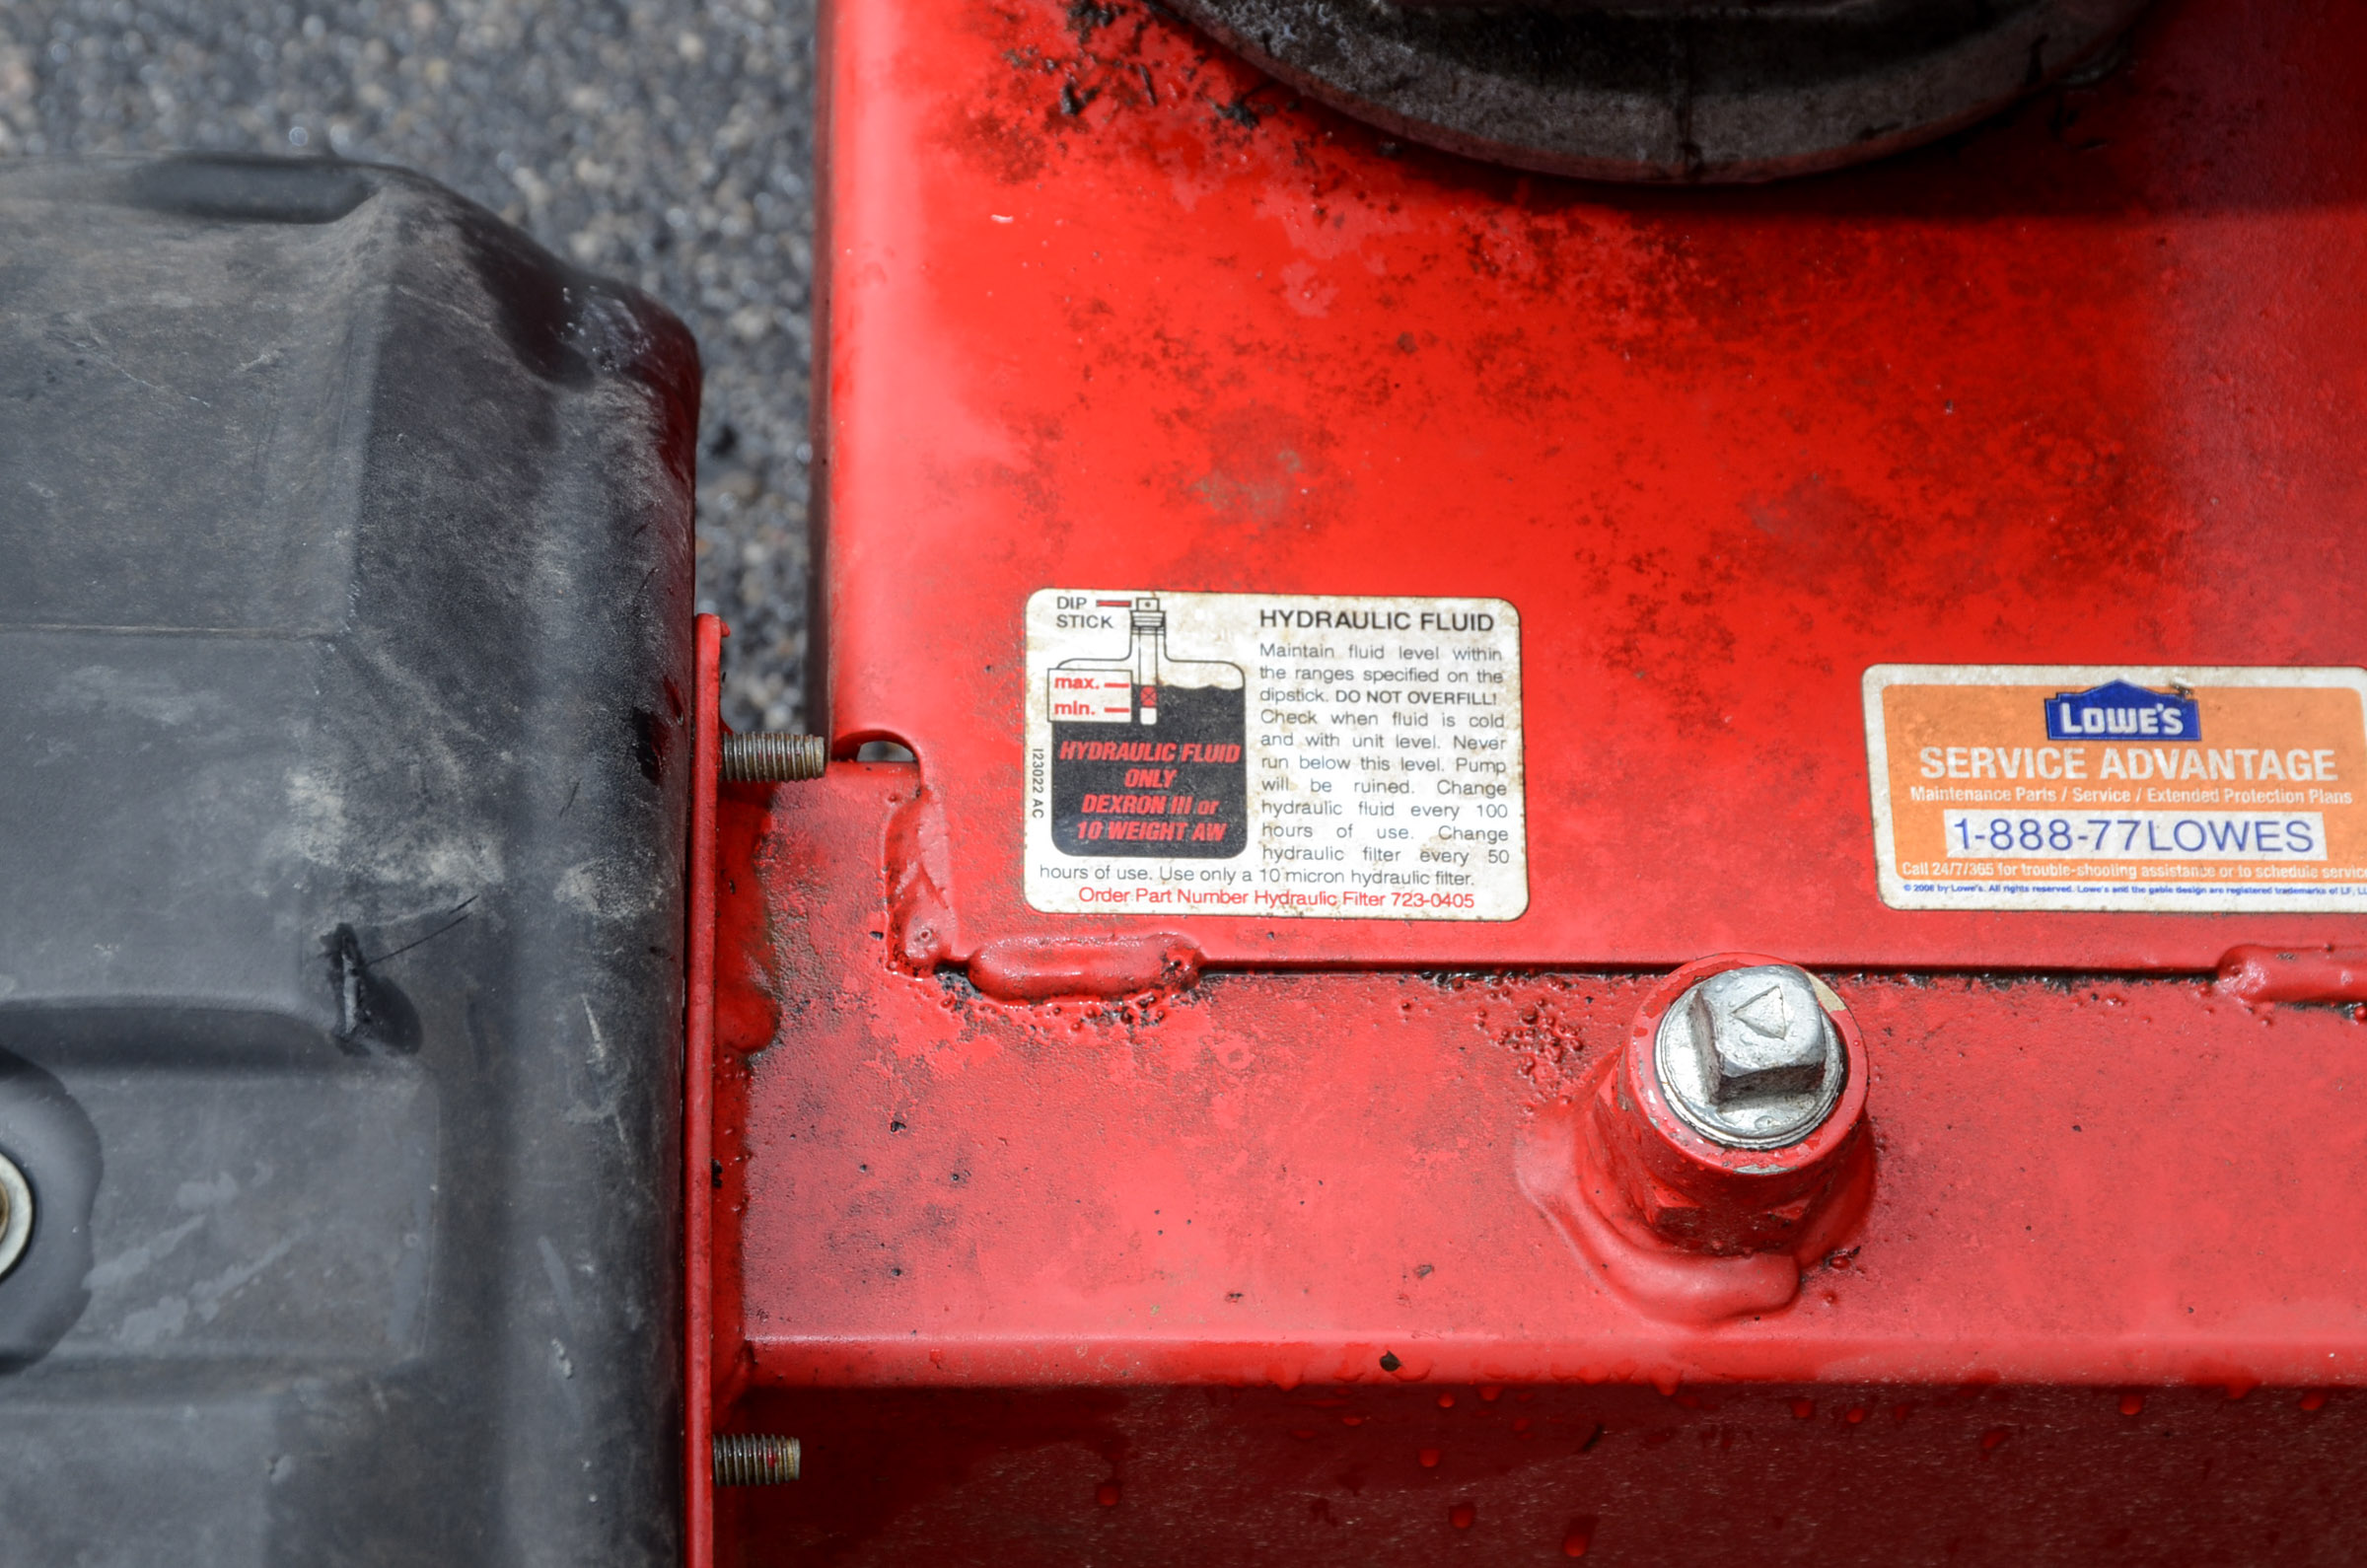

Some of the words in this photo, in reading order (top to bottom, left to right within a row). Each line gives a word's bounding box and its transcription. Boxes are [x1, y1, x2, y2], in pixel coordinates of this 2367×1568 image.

[1056, 596, 1087, 610] DIP
[1056, 614, 1113, 629] STICK
[1260, 609, 1411, 630] HYDRAULIC
[1421, 611, 1495, 631] FLUID
[1260, 643, 1335, 659] Maintain
[1349, 644, 1385, 660] fluid
[1399, 646, 1440, 661] level
[1453, 647, 1502, 662] within
[1054, 677, 1100, 690] max.
[1260, 666, 1286, 680] the
[1295, 670, 1354, 684] ranges
[1363, 668, 1439, 684] specified
[1448, 671, 1469, 683] on
[1477, 670, 1504, 683] the
[1260, 687, 1328, 705] dipstick.
[1335, 690, 1361, 703] DO
[1367, 690, 1401, 703] NOT
[1407, 691, 1497, 705] OVERFILL!
[1054, 701, 1096, 716] min.
[1260, 709, 1318, 725] Check
[1331, 711, 1378, 726] when
[1393, 711, 1429, 727] fluid
[1442, 713, 1456, 728] is
[1469, 713, 1505, 729] cold
[2060, 702, 2185, 736] LOWE'S
[1260, 732, 1294, 747] and
[1305, 733, 1340, 748] with
[1352, 733, 1385, 748] unit
[1397, 734, 1441, 749] level.
[1454, 735, 1506, 750] Never
[1059, 741, 1178, 762] HYDRAULIC
[1181, 744, 1241, 763] FLUID
[1262, 757, 1289, 769] run
[1300, 755, 1351, 770] below
[1361, 756, 1391, 771] this
[1400, 757, 1444, 772] level.
[1456, 758, 1507, 775] Pump
[1920, 747, 2087, 780] SERVICE
[2100, 748, 2338, 782] ADVANTAGE
[1124, 768, 1178, 789] ONLY
[1261, 777, 1289, 792] will
[1310, 778, 1332, 793] be
[1354, 779, 1415, 794] ruined.
[1437, 779, 1507, 799] Change
[1081, 794, 1167, 815] DEXRON
[1171, 795, 1193, 815] III
[1197, 800, 1220, 816] or
[1910, 786, 2012, 802] Maintenance
[2016, 786, 2056, 803] Parts
[2060, 786, 2068, 803] /
[2073, 787, 2131, 803] Service
[2135, 787, 2142, 803] /
[2147, 787, 2219, 804] Extended
[2224, 788, 2305, 805] Protection
[2309, 788, 2353, 805] Plans
[1033, 798, 1044, 819] AC
[1261, 800, 1342, 818] hydraulic
[1358, 801, 1395, 817] fluid
[1410, 805, 1461, 820] every
[1476, 804, 1508, 819] 100
[1077, 820, 1104, 840] 10
[1108, 820, 1187, 841] WEIGHT
[1191, 822, 1228, 842] AW
[1262, 822, 1314, 838] hours
[1336, 823, 1353, 838] of
[1377, 826, 1414, 839] use.
[1438, 824, 1509, 845] Change
[1954, 818, 2314, 853] 1-888-77LOWES
[1262, 846, 1344, 864] hydraulic
[1362, 846, 1401, 862] filter
[1419, 851, 1470, 867] every
[1487, 849, 1510, 864] 50
[1040, 864, 1089, 880] hours
[1095, 865, 1111, 881] of
[1116, 869, 1153, 881] use.
[1159, 866, 1194, 882] Use
[1200, 866, 1237, 886] only
[1242, 871, 1253, 883] a
[1260, 868, 1281, 883] 10
[1285, 869, 1345, 884] micron
[1351, 869, 1430, 888] hydraulic
[1435, 870, 1474, 887] filter.
[1901, 861, 1929, 877] Call
[1932, 862, 1994, 877] 24/7/365
[1998, 862, 2017, 877] for
[2022, 863, 2137, 880] trouble-shooting
[2141, 864, 2216, 879] assistance
[2219, 866, 2234, 879] or
[2238, 864, 2253, 879] to
[2256, 864, 2319, 880] schedule
[1079, 887, 1130, 902] Order
[1136, 888, 1173, 903] Part
[1177, 889, 1249, 904] Number
[1255, 890, 1337, 909] Hydraulic
[1342, 891, 1386, 907] Filter
[1391, 891, 1474, 908] 723-0405
[1937, 884, 1949, 893] by
[2003, 885, 2030, 894] rights
[2176, 886, 2206, 895] design
[2226, 887, 2273, 895] registered
[2274, 887, 2327, 895] trademarks
